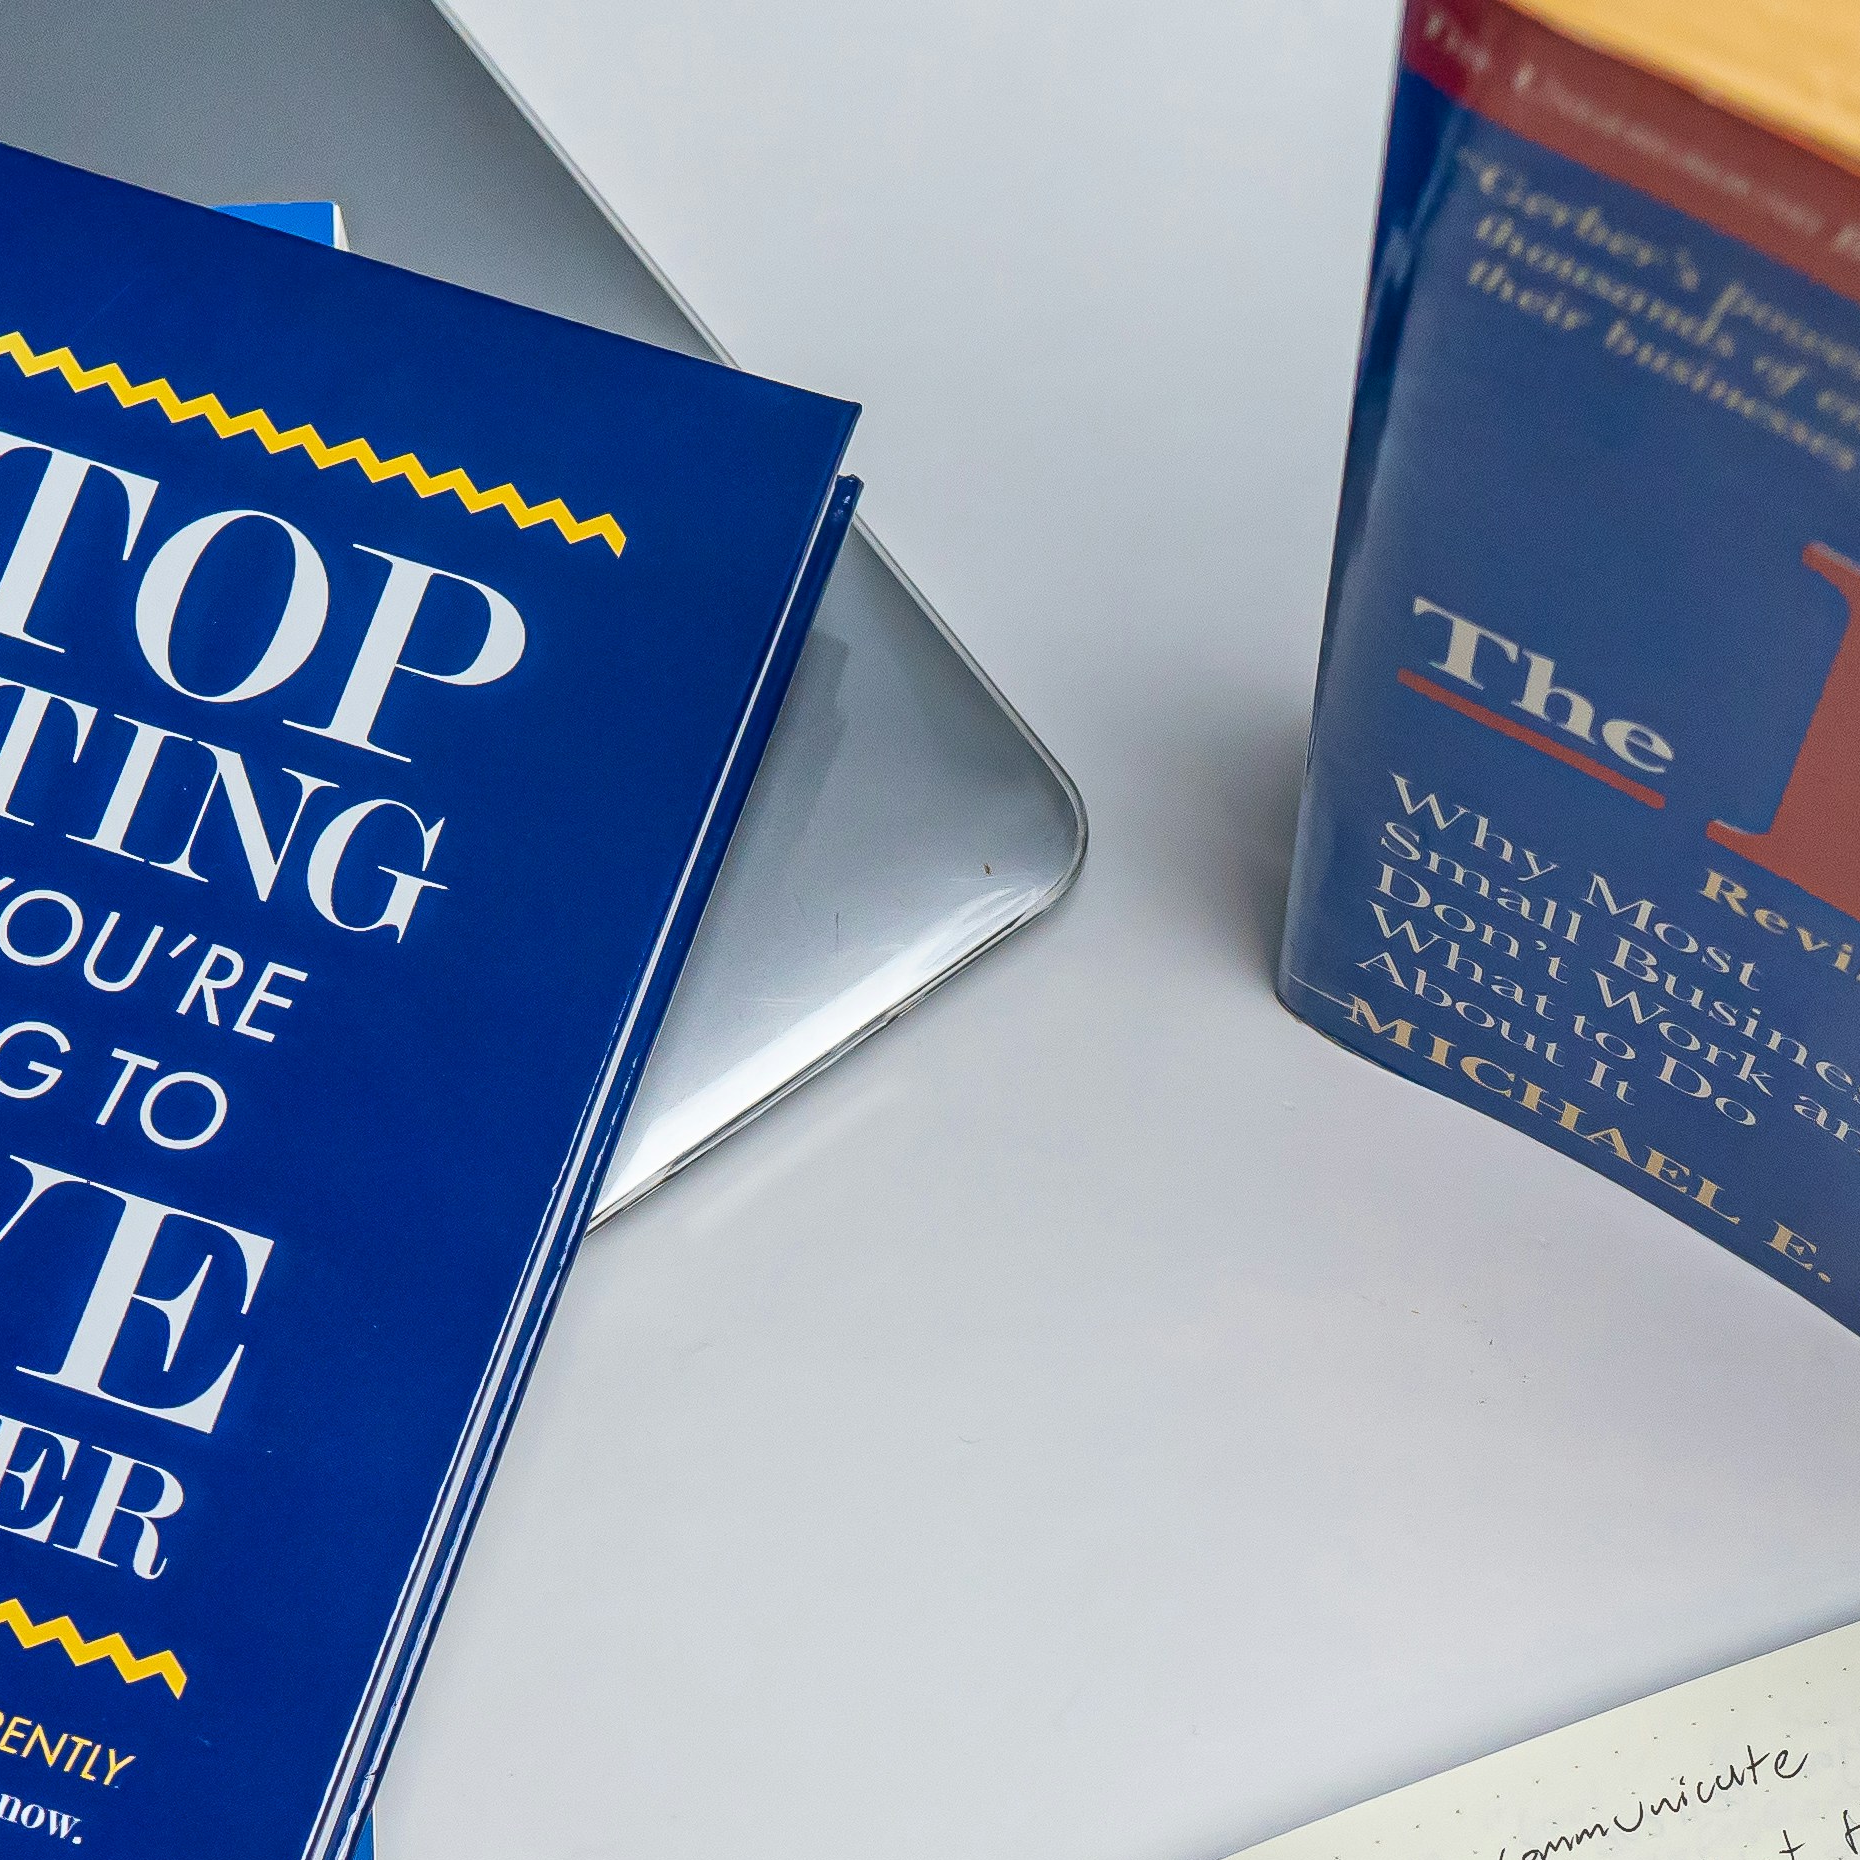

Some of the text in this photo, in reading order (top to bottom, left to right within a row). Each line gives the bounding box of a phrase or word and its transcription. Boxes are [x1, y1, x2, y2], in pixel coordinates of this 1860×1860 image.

[1411, 596, 1676, 776] The
[1376, 864, 1572, 985] Don't
[1594, 970, 1777, 1096] Work
[1379, 821, 1582, 947] Small
[1391, 772, 1764, 993] Why Most
[95, 1047, 228, 1150] TO
[1355, 952, 1637, 1109] About It
[1368, 901, 1759, 1128] What to Do
[1342, 993, 1742, 1225] MICHAEL
[1764, 1219, 1834, 1284] E.
